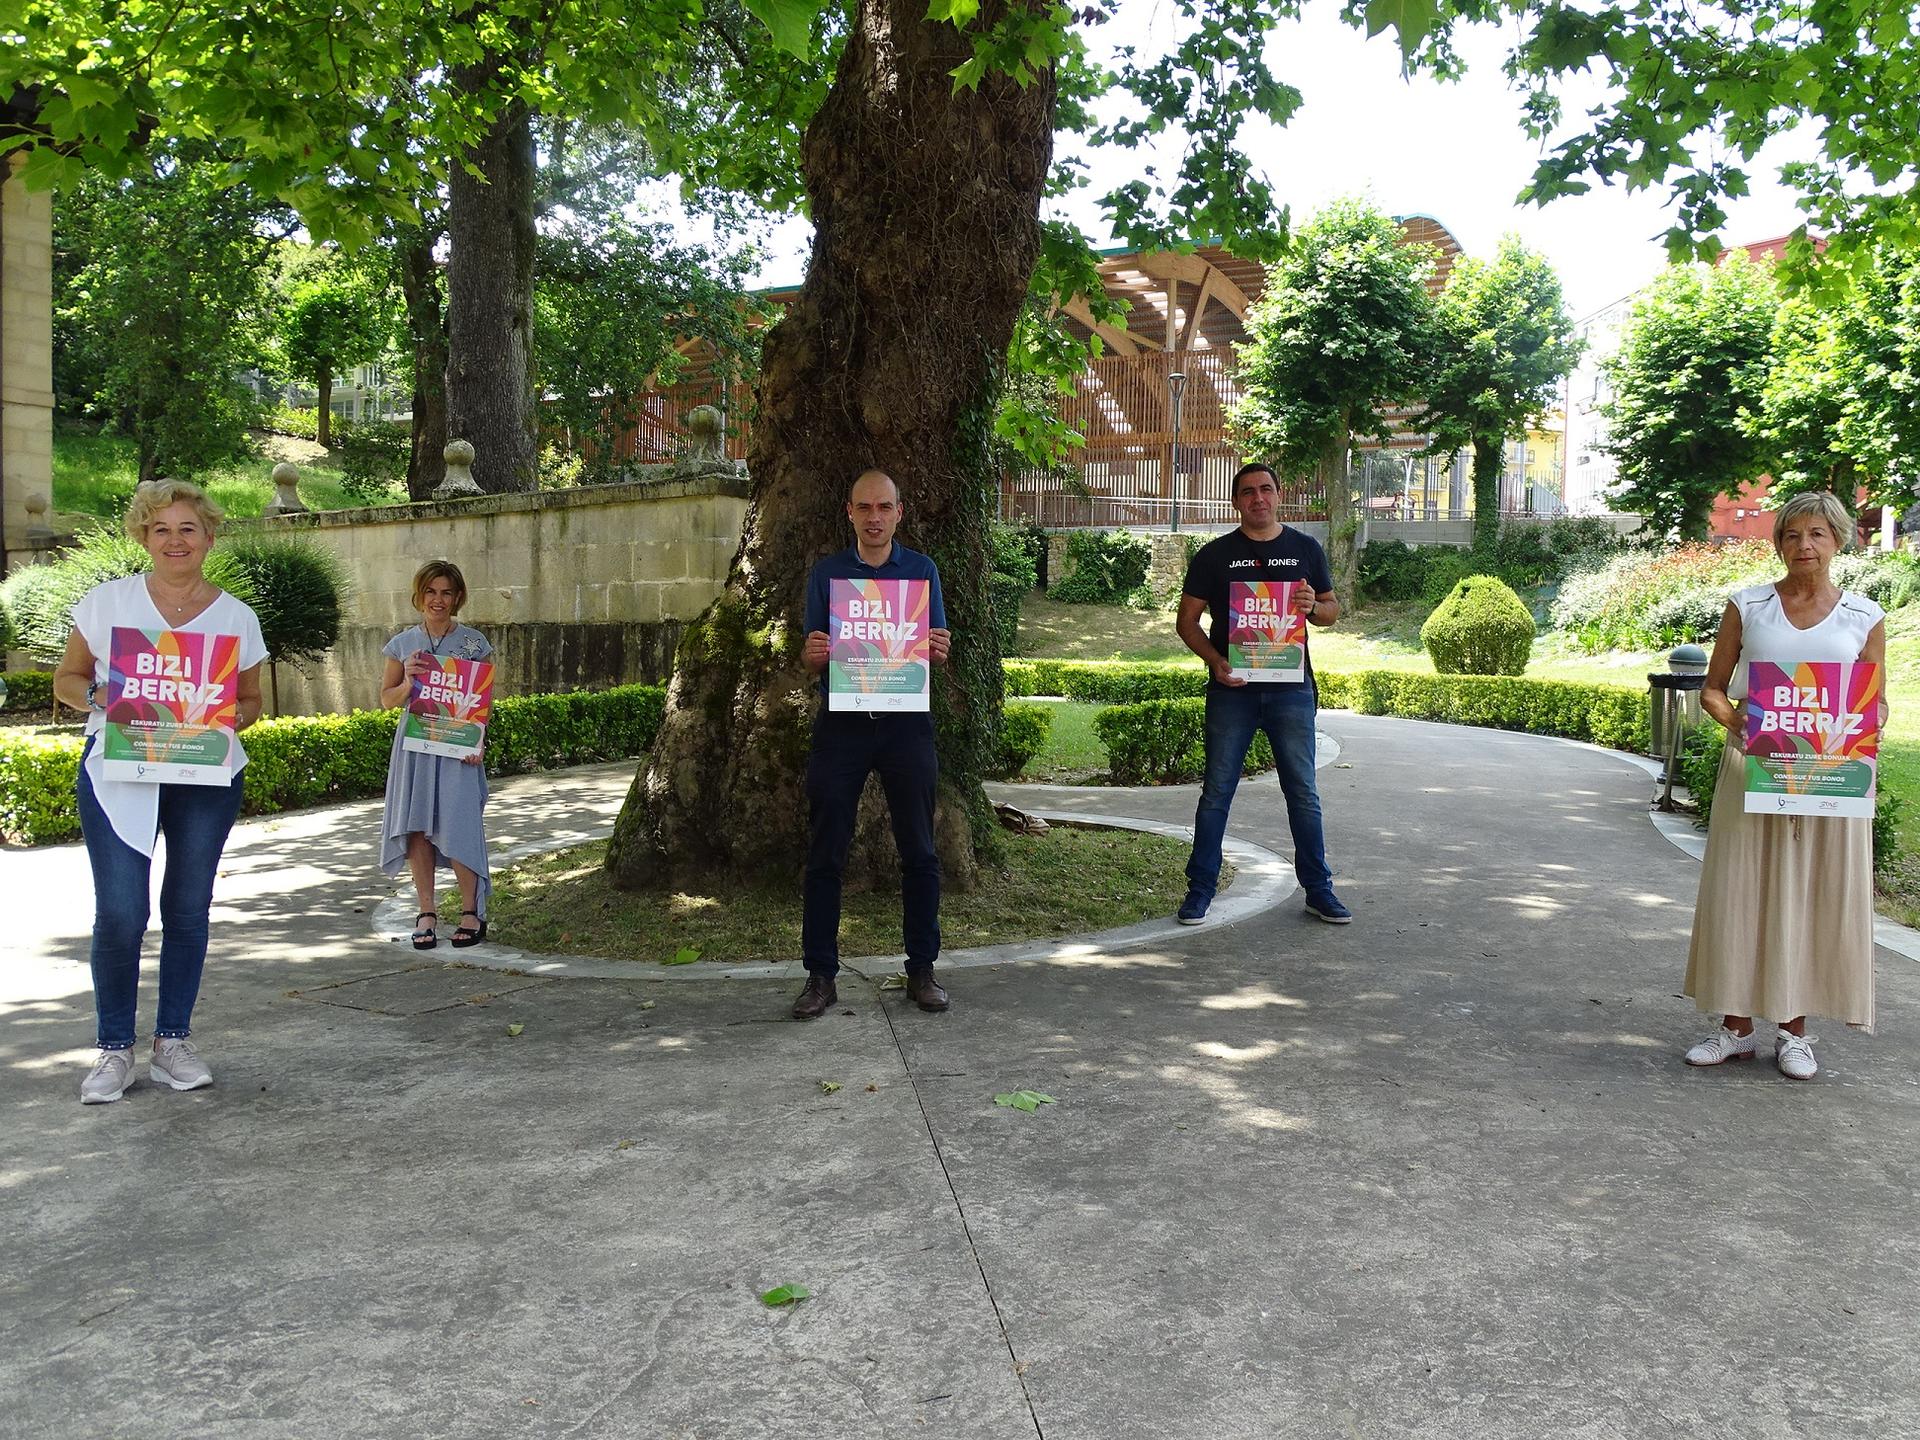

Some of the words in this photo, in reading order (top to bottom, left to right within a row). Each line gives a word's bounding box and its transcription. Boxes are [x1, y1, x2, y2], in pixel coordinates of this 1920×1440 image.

[1229, 559, 1256, 568] JACK
[848, 600, 892, 619] BIZI
[1244, 597, 1278, 612] BIZI
[839, 621, 919, 641] BERRIZ
[1236, 614, 1298, 629] BERRIZ
[136, 652, 192, 678] BIZI
[429, 670, 463, 689] BIZI
[122, 677, 225, 705] BERRIZ
[418, 685, 482, 708] BERRIZ
[1773, 686, 1829, 709] BIZI
[1760, 710, 1864, 735] BERRIZ
[1769, 752, 1804, 760] ESKURATU
